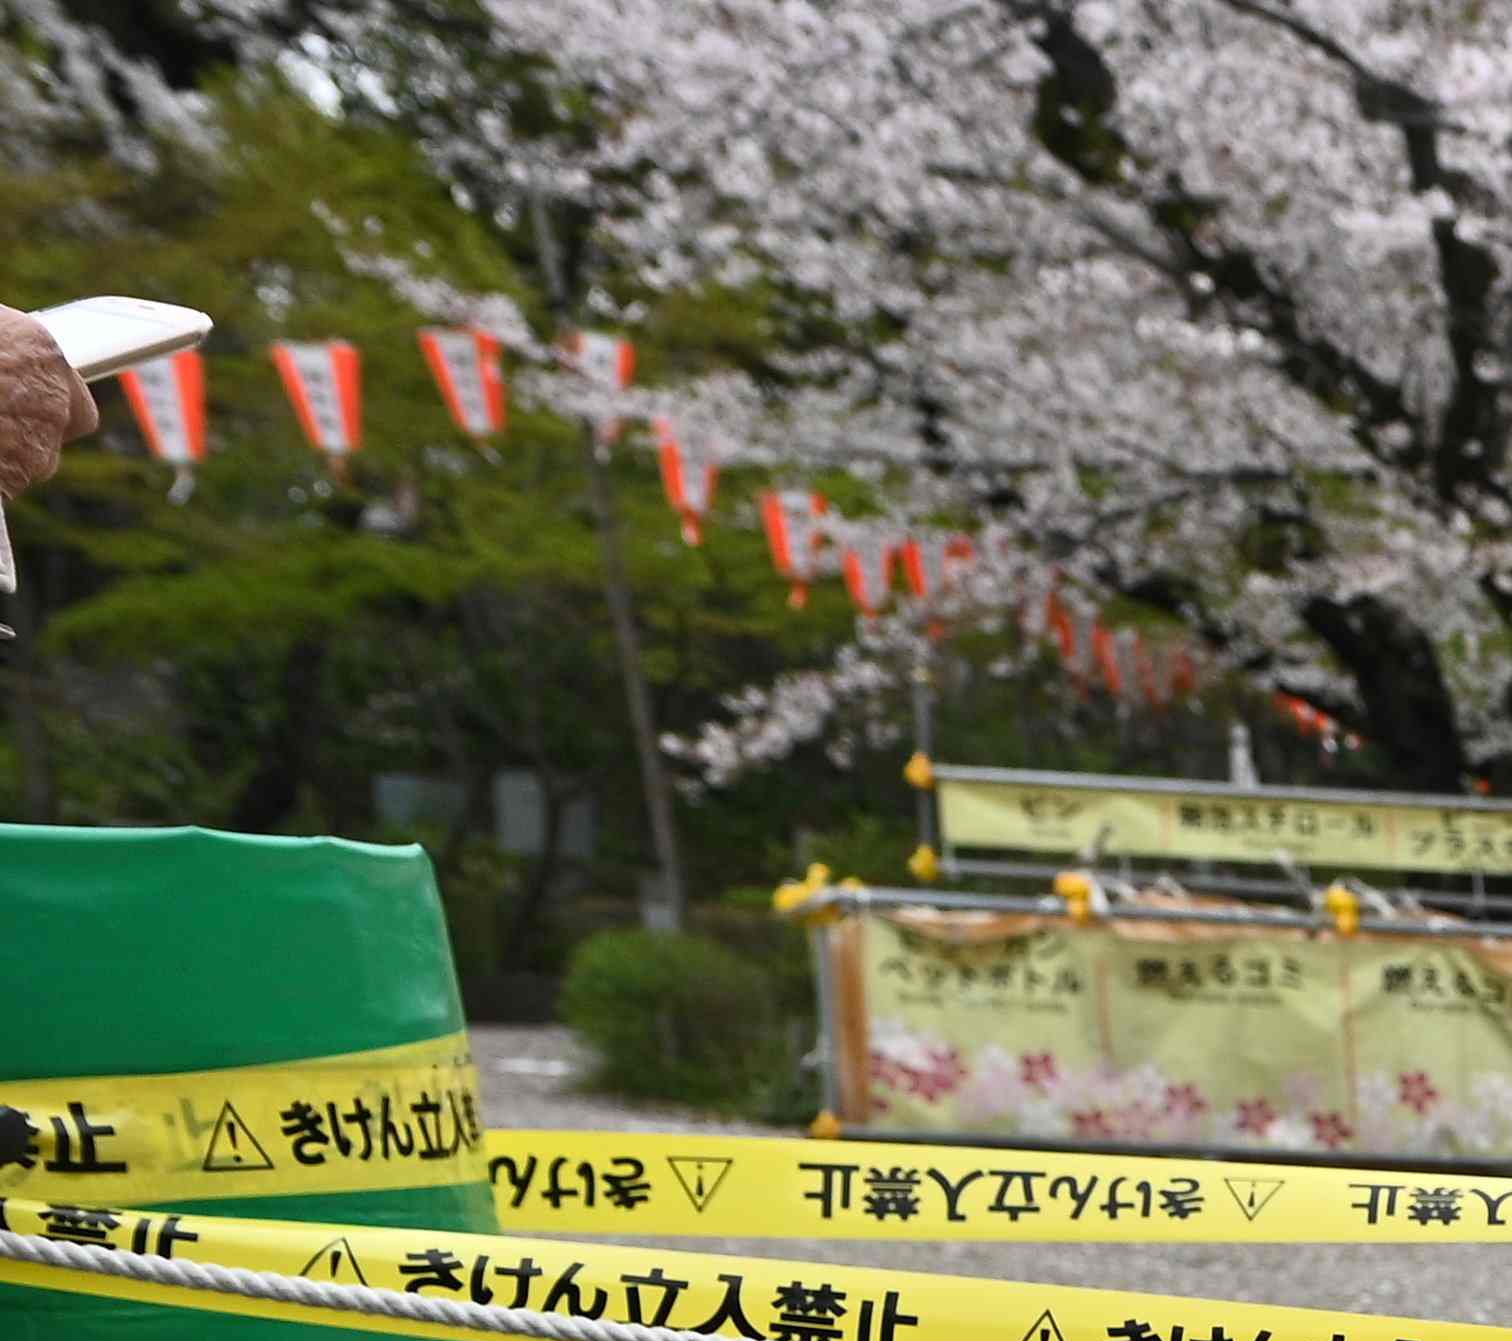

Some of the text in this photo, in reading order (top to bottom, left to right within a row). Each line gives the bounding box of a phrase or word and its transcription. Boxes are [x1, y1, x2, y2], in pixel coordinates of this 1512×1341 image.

[798, 1162, 1206, 1222] きけん立入禁止
